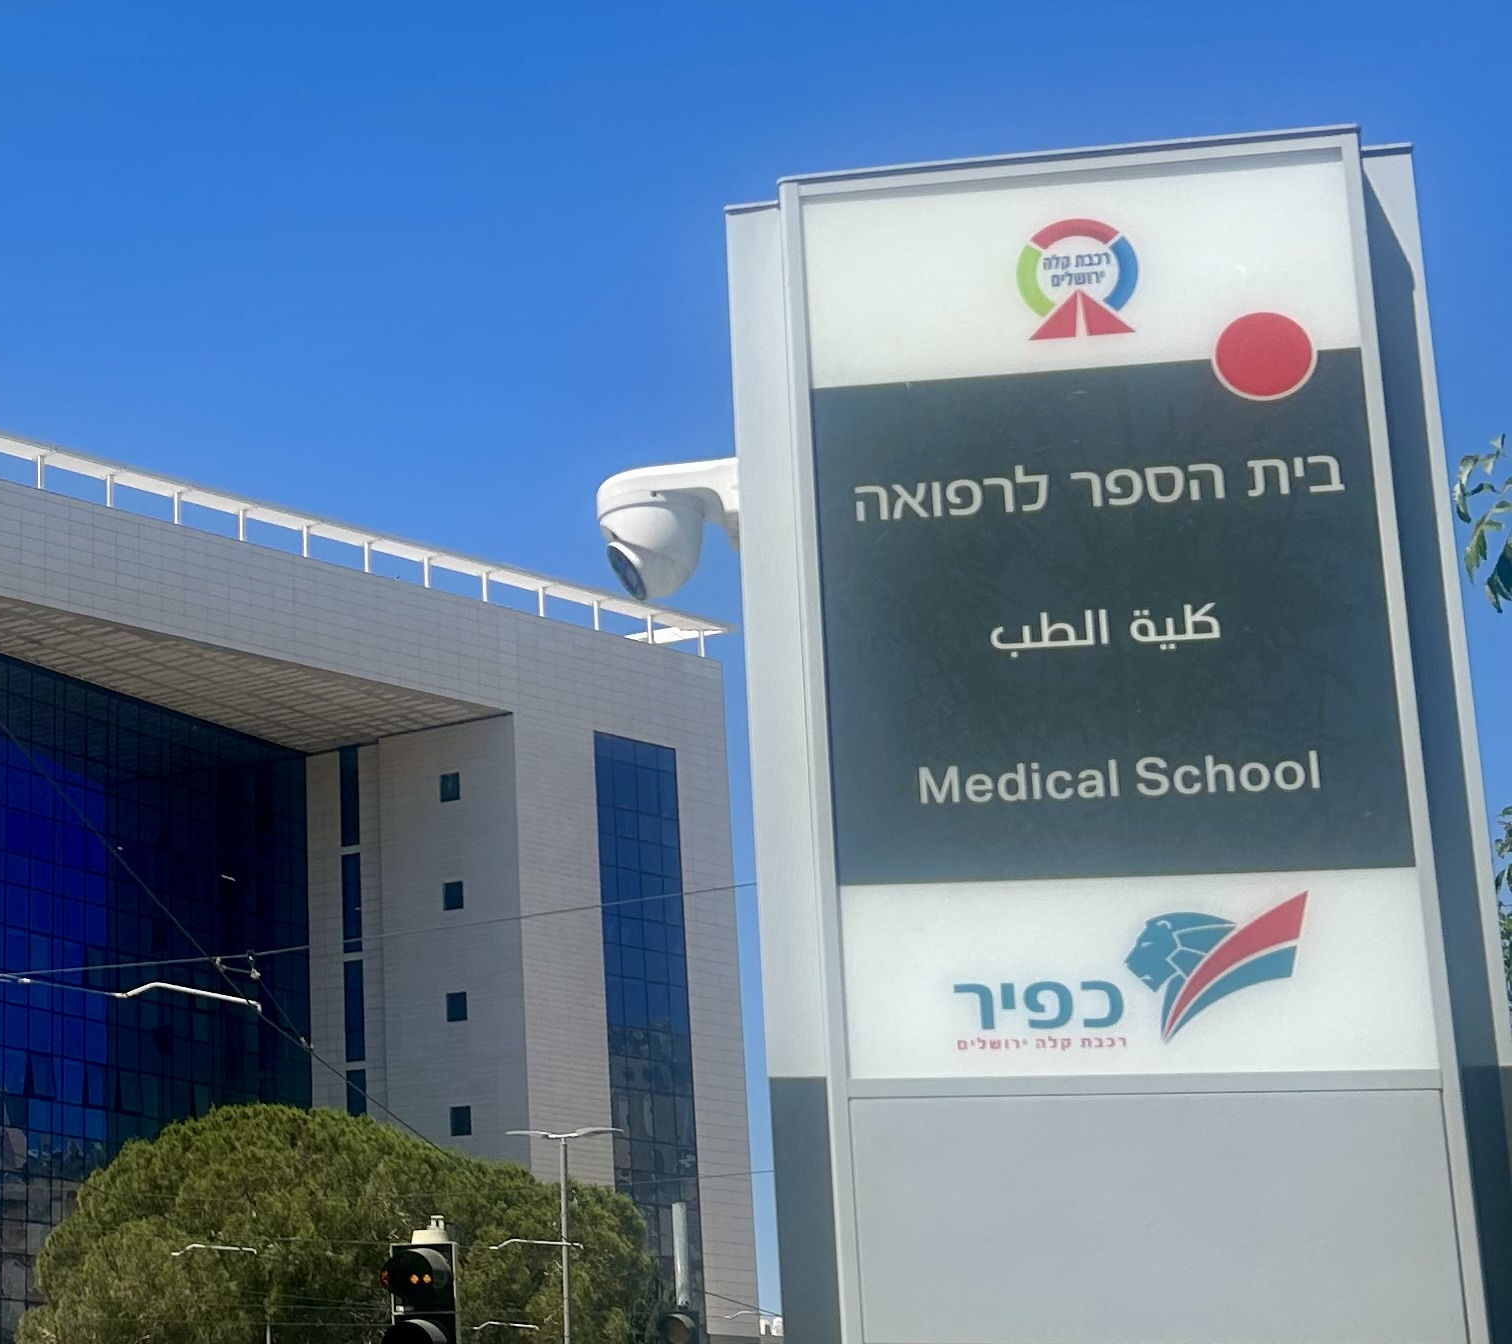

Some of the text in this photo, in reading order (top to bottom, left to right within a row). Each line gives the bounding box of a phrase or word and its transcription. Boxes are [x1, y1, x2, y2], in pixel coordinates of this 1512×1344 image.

[1043, 252, 1111, 270] רכבת קלה
[1051, 271, 1106, 287] ירושלים
[854, 455, 1345, 522] בית הספר לרפואה
[990, 602, 1222, 658] كلية الطب
[918, 750, 1321, 804] Medical School
[953, 980, 1124, 1030] כפיר
[957, 1036, 1127, 1051] רכבת קלה ירושלים
